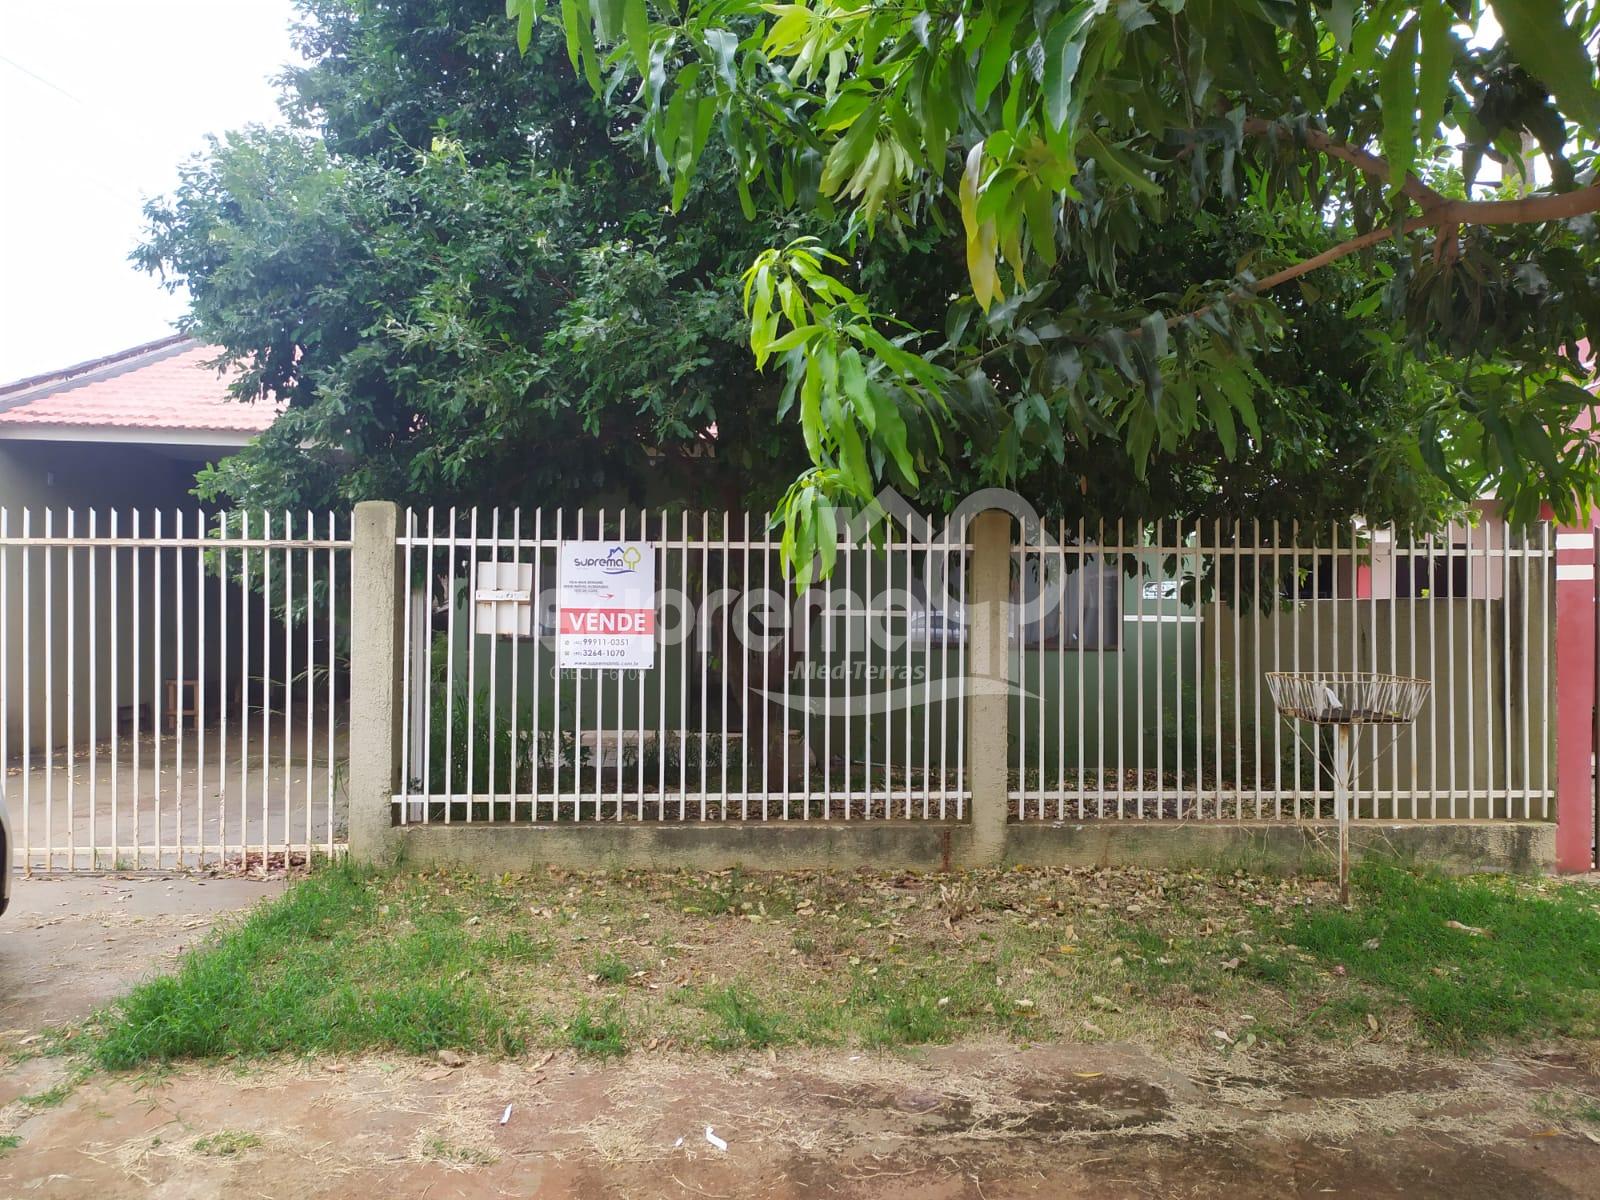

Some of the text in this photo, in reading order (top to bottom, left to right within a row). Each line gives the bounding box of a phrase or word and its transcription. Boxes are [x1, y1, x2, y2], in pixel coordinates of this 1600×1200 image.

[574, 558, 623, 567] suprema
[568, 612, 646, 632] VENDE
[583, 638, 629, 646] 99911-0351
[583, 649, 625, 657] 3264-1070
